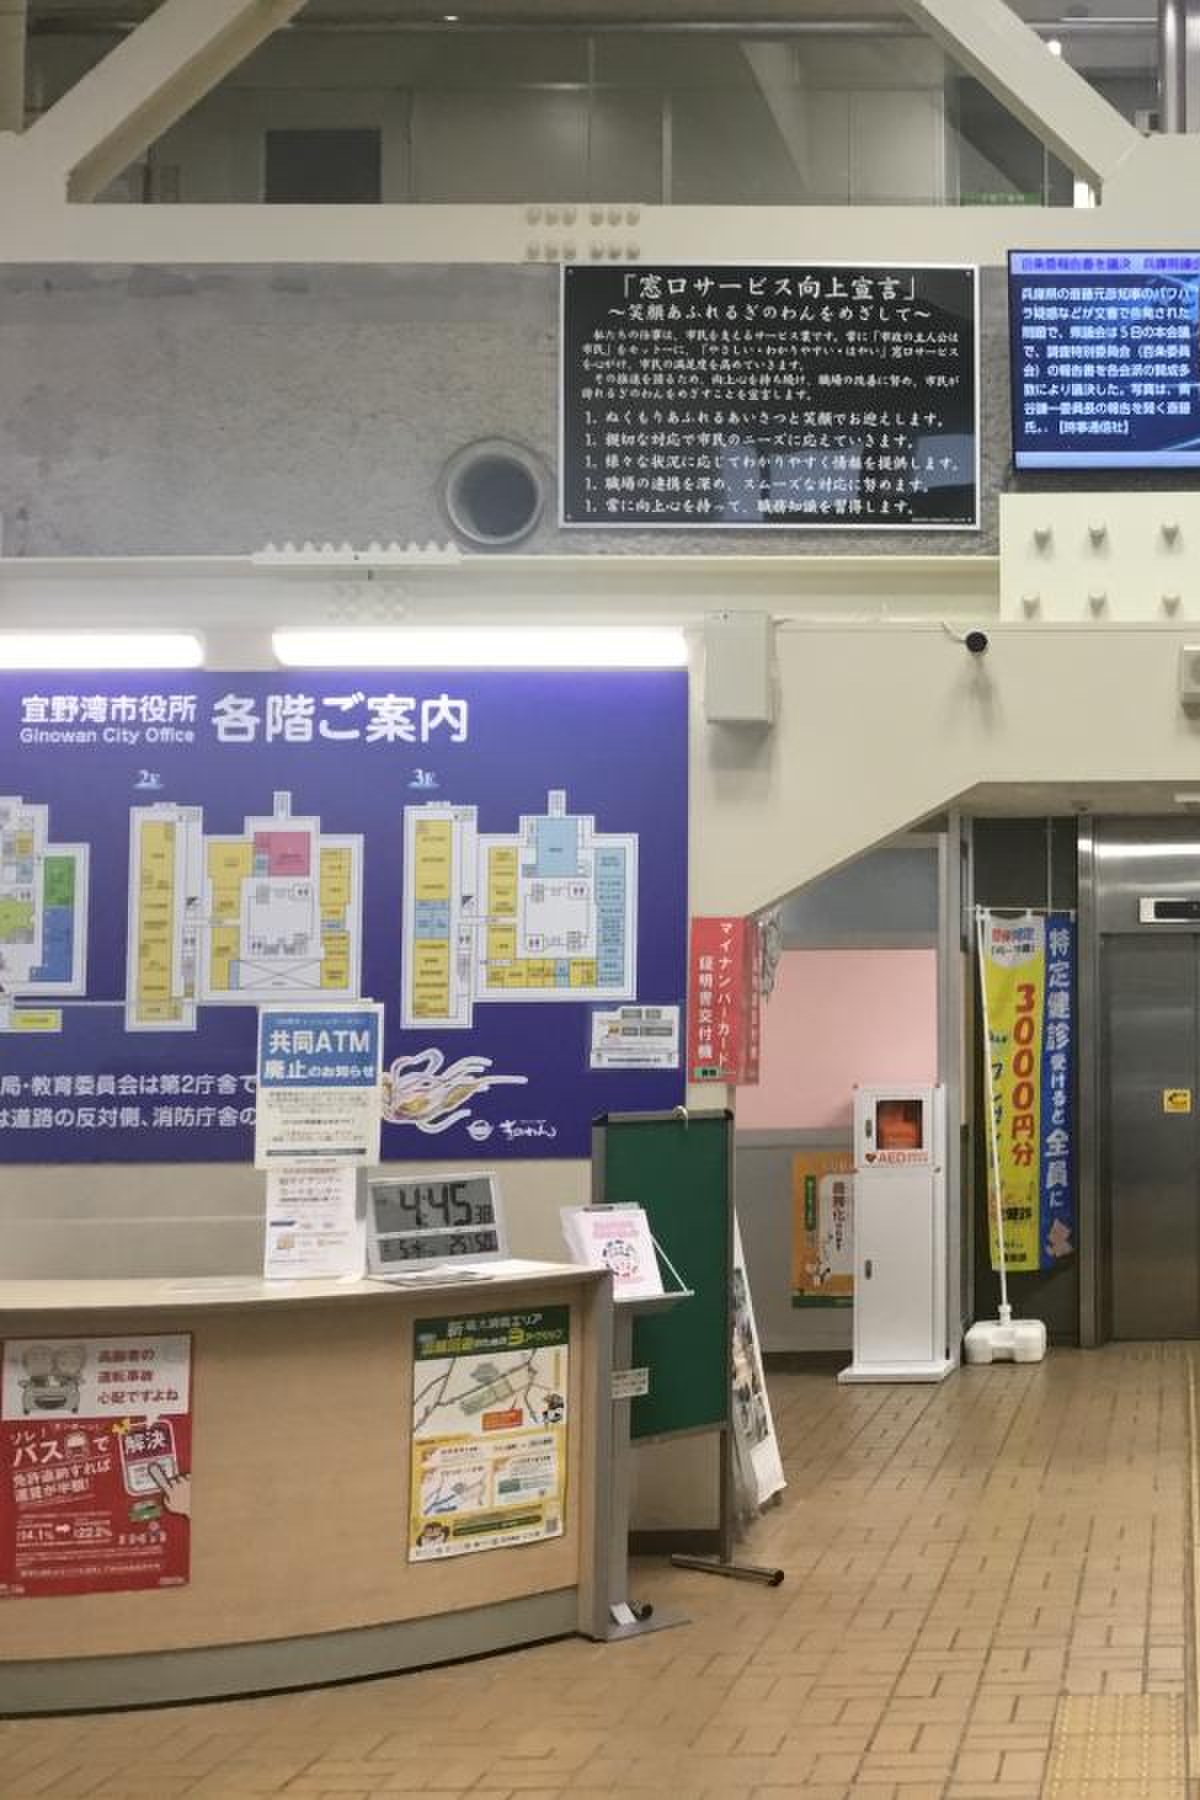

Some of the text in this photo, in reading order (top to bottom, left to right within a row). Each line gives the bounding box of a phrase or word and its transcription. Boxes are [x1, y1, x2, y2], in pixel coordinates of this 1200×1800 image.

[624, 273, 915, 301] 「窓口サービス向上宣言」
[21, 694, 198, 723] 宜野湾市役所
[211, 691, 469, 743] 各階ご案内
[20, 727, 196, 746] Ginowan City Office
[717, 922, 733, 1067] マイナンバーカード
[269, 1028, 369, 1054] 共同ATM
[1011, 982, 1036, 1167] 3000円分
[399, 1183, 472, 1227] 4:45
[13, 1440, 64, 1467] バス
[125, 1429, 167, 1453] 解決
